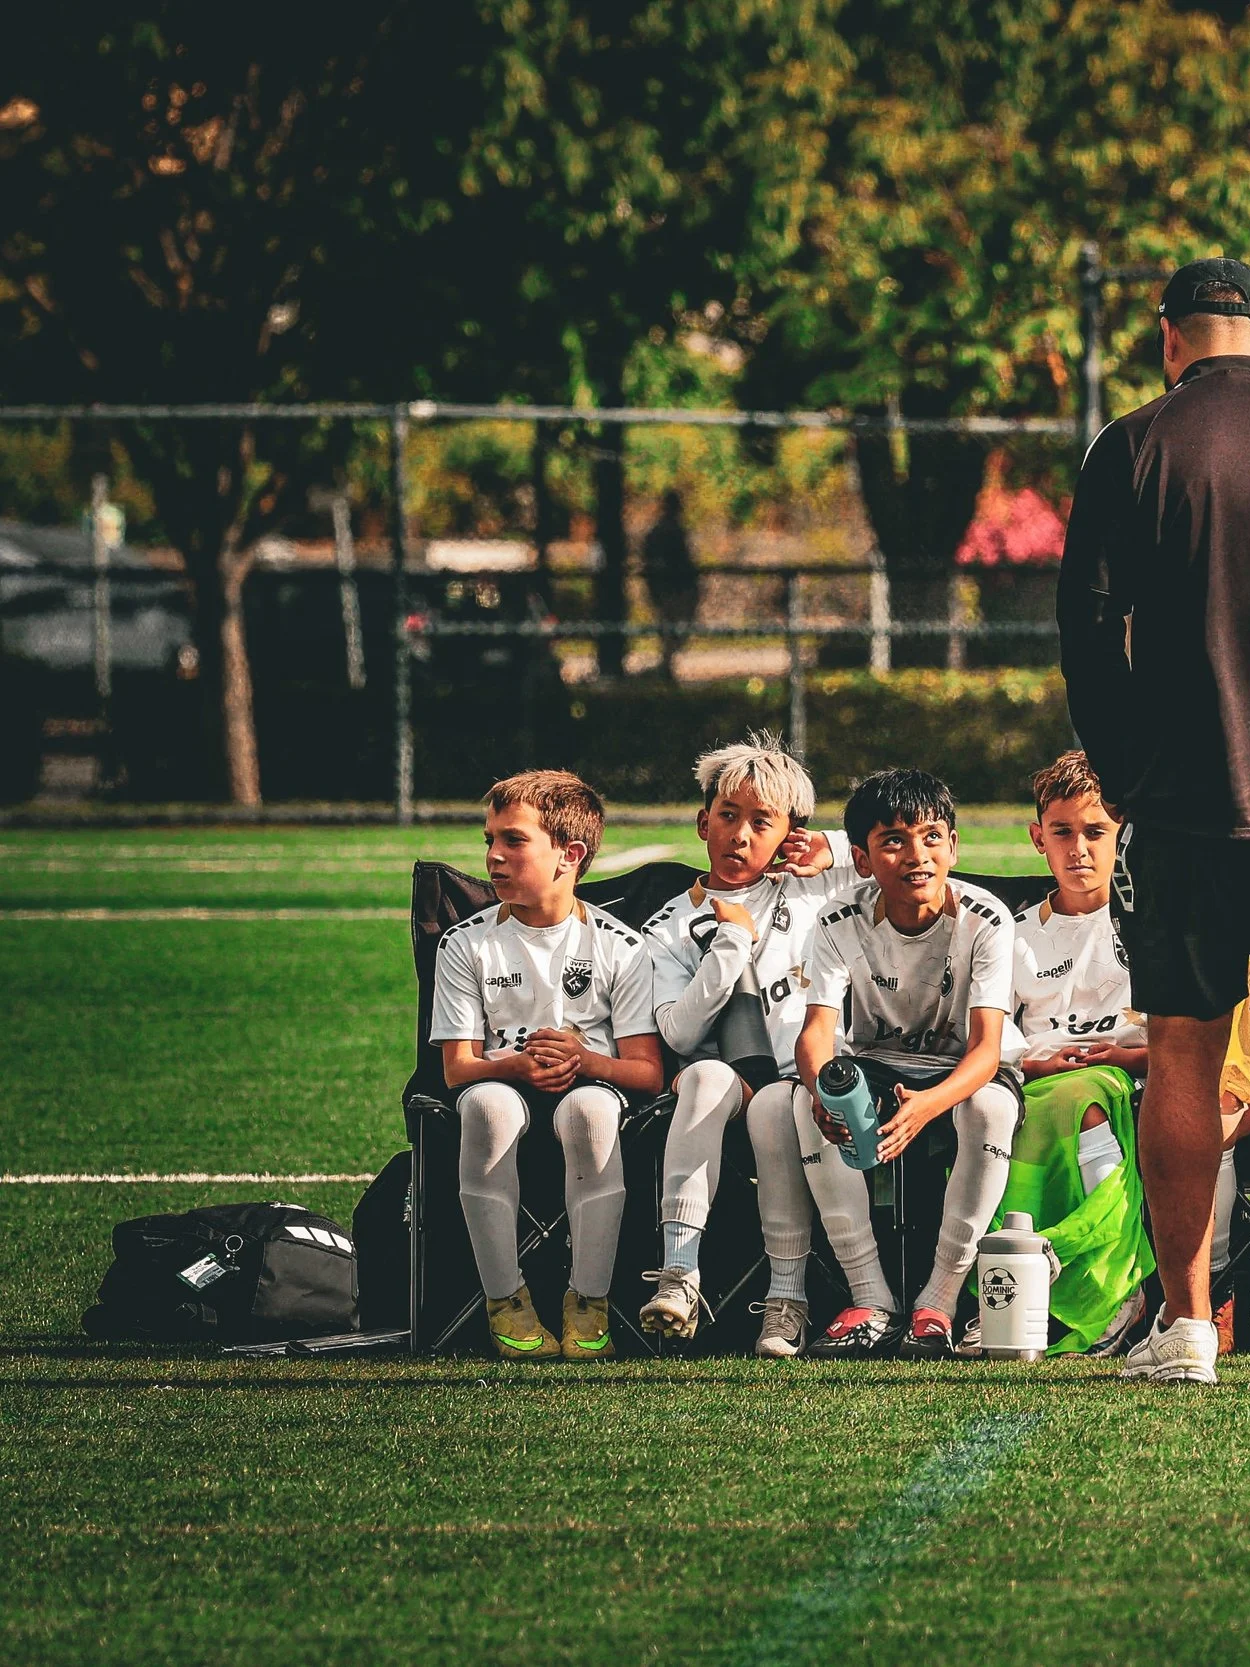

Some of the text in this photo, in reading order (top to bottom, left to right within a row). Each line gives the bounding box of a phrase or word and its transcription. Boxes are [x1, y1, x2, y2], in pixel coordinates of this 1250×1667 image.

[1036, 958, 1073, 978] capelli
[485, 972, 522, 988] capelli
[982, 1284, 1016, 1295] DOMINIC
